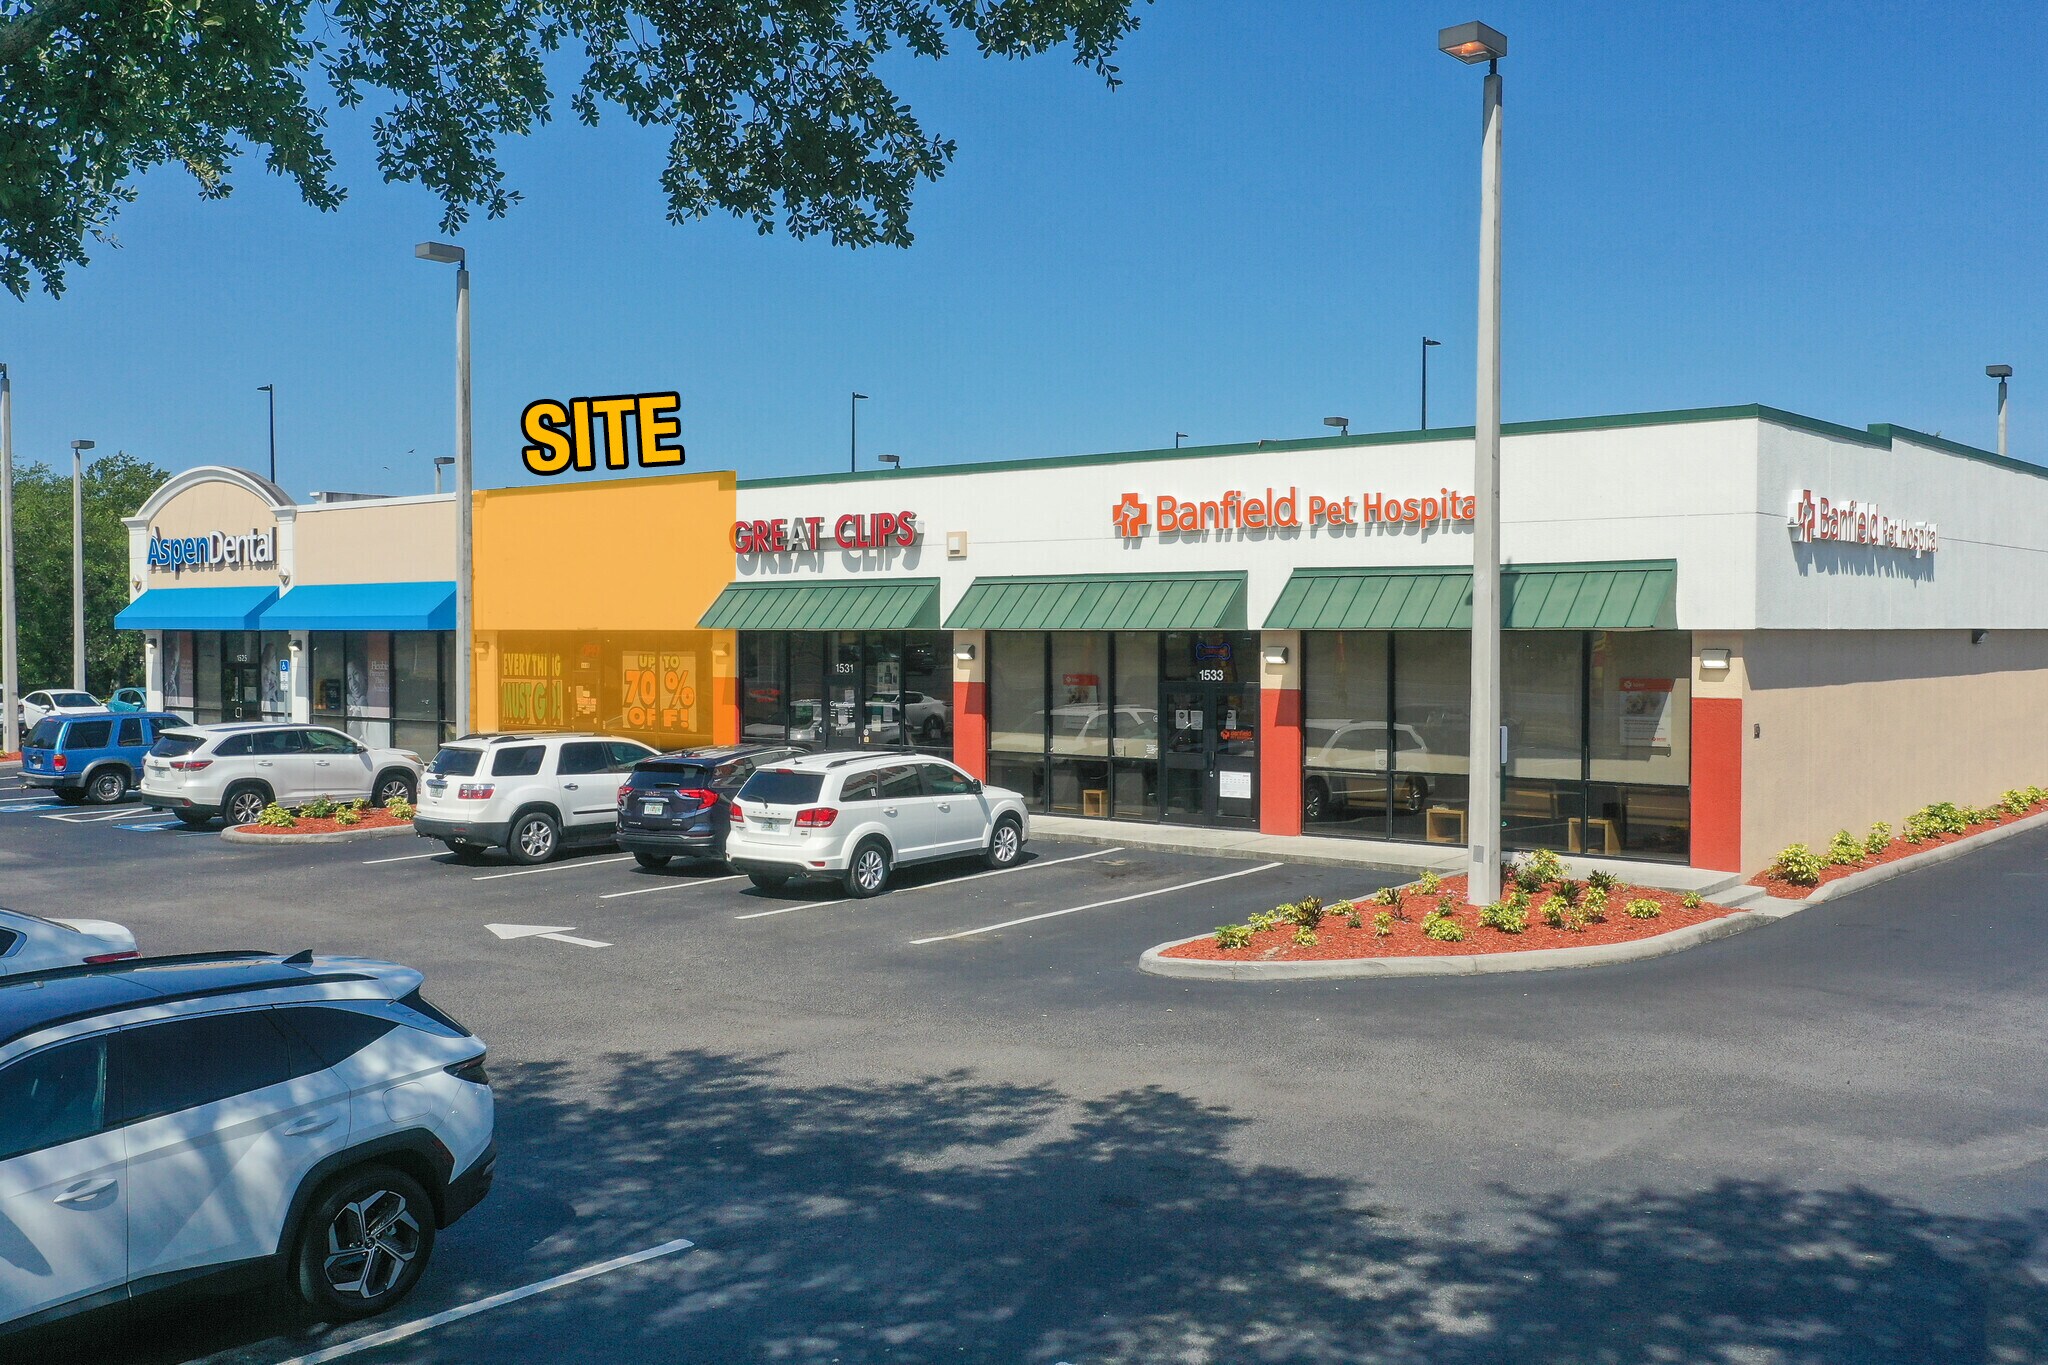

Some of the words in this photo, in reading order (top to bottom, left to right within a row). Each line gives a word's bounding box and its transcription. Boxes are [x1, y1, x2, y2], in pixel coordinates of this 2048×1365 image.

[1157, 487, 1299, 532] Banfield
[1308, 496, 1355, 525] Pet
[1363, 488, 1476, 529] Hospita
[728, 516, 824, 554] GREAT
[834, 510, 917, 549] CLIPS
[1820, 497, 1879, 545] Banfield
[1882, 516, 1898, 547] Pet
[1901, 519, 1939, 558] Hospital
[638, 654, 656, 669] UP
[662, 655, 680, 670] TO
[836, 663, 854, 673] 1531
[1199, 669, 1224, 681] 1533
[503, 682, 532, 720] MUST
[627, 707, 690, 729] OFF!
